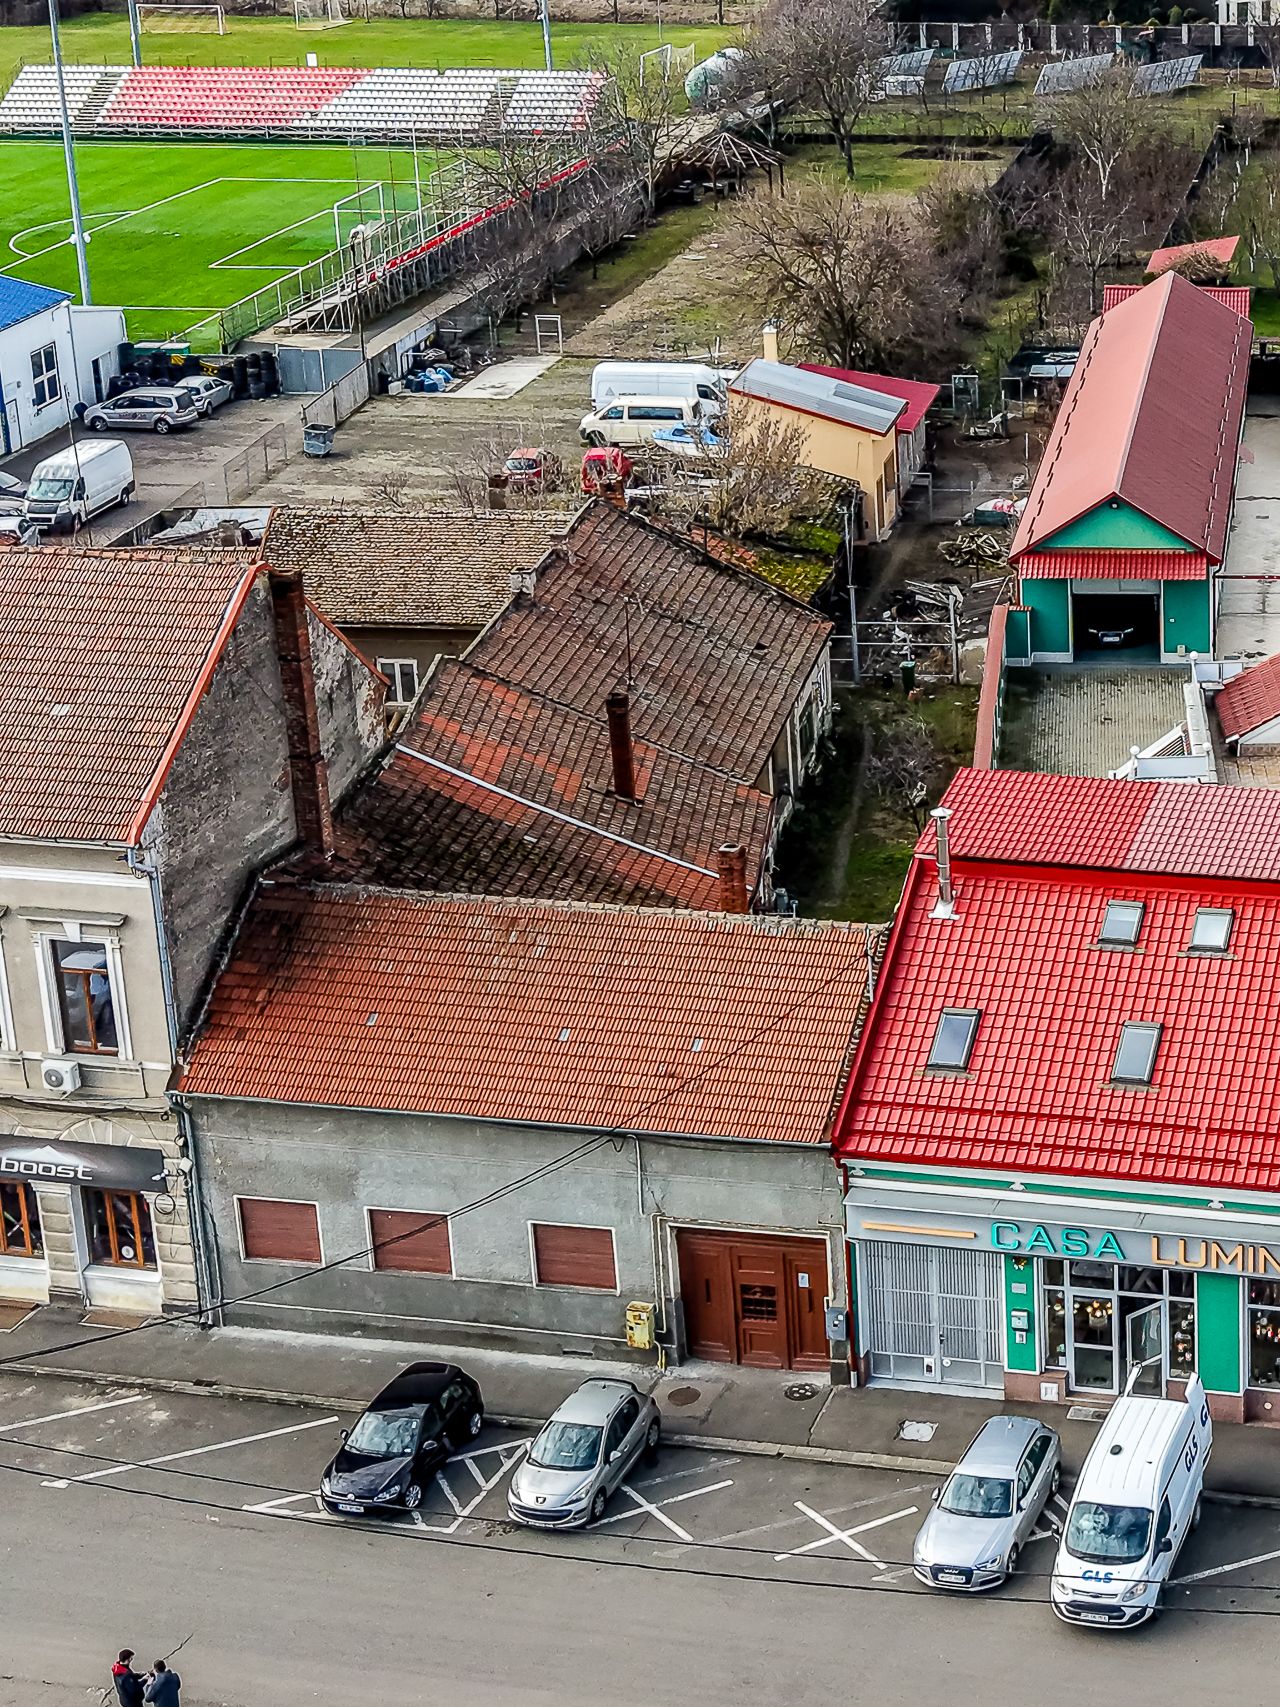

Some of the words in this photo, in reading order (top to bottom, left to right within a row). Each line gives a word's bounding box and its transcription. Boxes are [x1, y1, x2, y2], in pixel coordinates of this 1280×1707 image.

[1, 1156, 93, 1180] boost
[991, 1222, 1126, 1260] CASA
[1185, 1434, 1198, 1473] GLS
[1081, 1569, 1114, 1584] GLS
